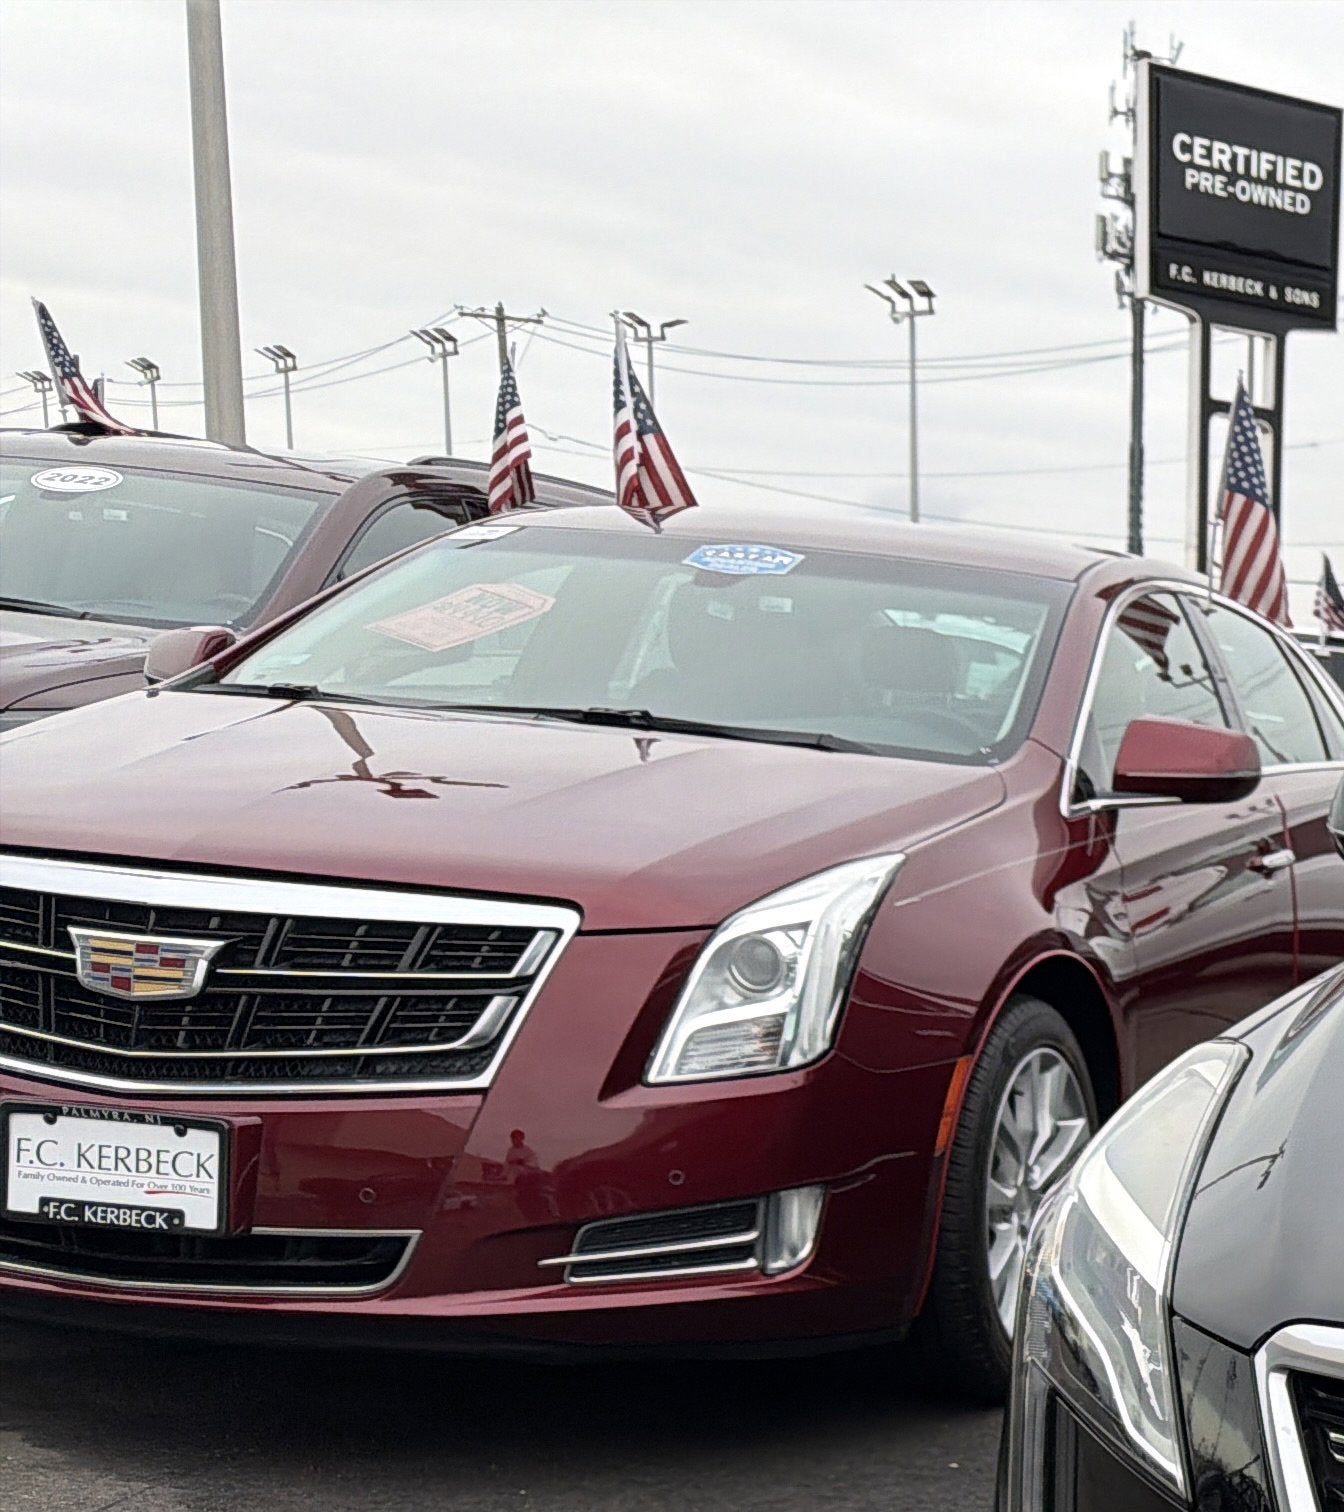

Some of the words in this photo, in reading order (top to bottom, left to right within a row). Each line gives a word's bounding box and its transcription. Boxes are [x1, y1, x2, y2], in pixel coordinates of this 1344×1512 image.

[1172, 132, 1323, 191] CERTIFIED
[1184, 168, 1311, 215] PRE-OWNED
[1169, 263, 1197, 284] F.C.
[1202, 270, 1264, 297] KERBECK
[1284, 286, 1320, 308] SONS
[42, 472, 111, 486] 2022
[62, 1106, 137, 1123] PALMYRA,
[16, 1137, 65, 1167] F.C.
[77, 1142, 215, 1179] KERBECK
[17, 1171, 45, 1182] Family
[47, 1172, 78, 1183] Owned
[81, 1175, 87, 1183] &
[89, 1176, 129, 1187] Operated
[131, 1180, 145, 1189] For
[147, 1181, 168, 1190] Over
[171, 1183, 186, 1191] 100
[189, 1184, 210, 1195] Years
[48, 1202, 79, 1221] F.C.
[84, 1205, 169, 1229] KERBECK
